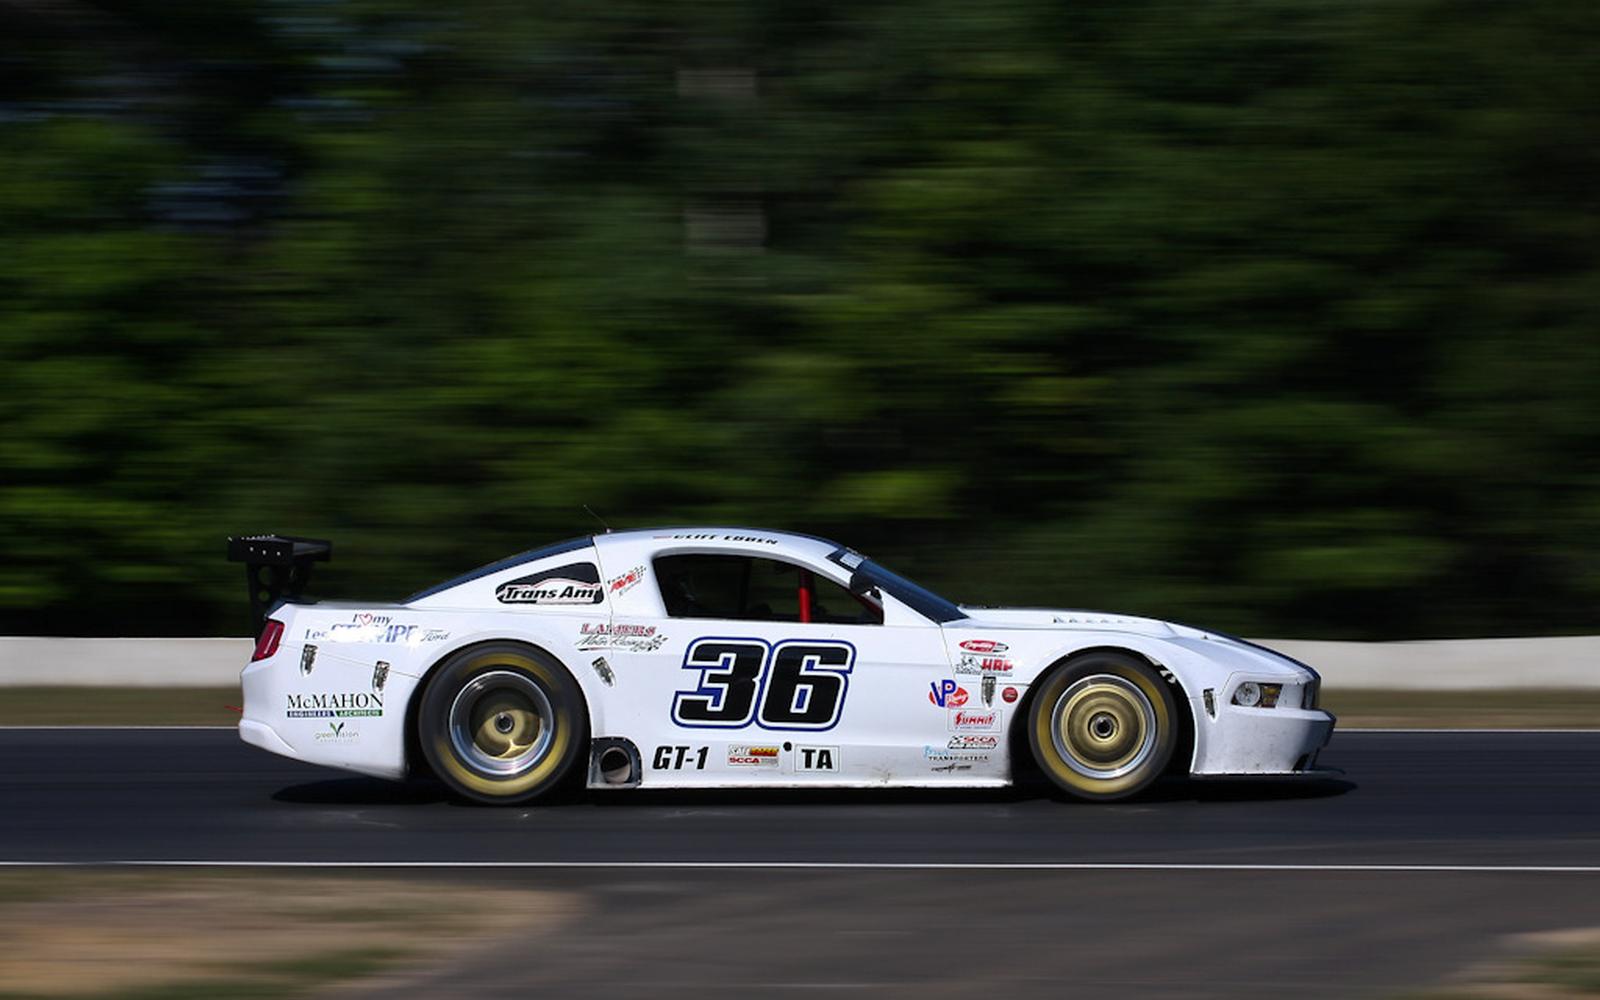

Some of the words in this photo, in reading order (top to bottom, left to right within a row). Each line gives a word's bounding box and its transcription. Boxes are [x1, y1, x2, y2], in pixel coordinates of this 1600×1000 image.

[505, 587, 557, 599] Trans
[559, 586, 594, 599] Am
[372, 615, 393, 625] my
[670, 637, 857, 732] 36
[930, 680, 957, 708] VP
[287, 693, 383, 708] McMAHON
[653, 746, 709, 770] GT-1
[801, 749, 833, 769] TA
